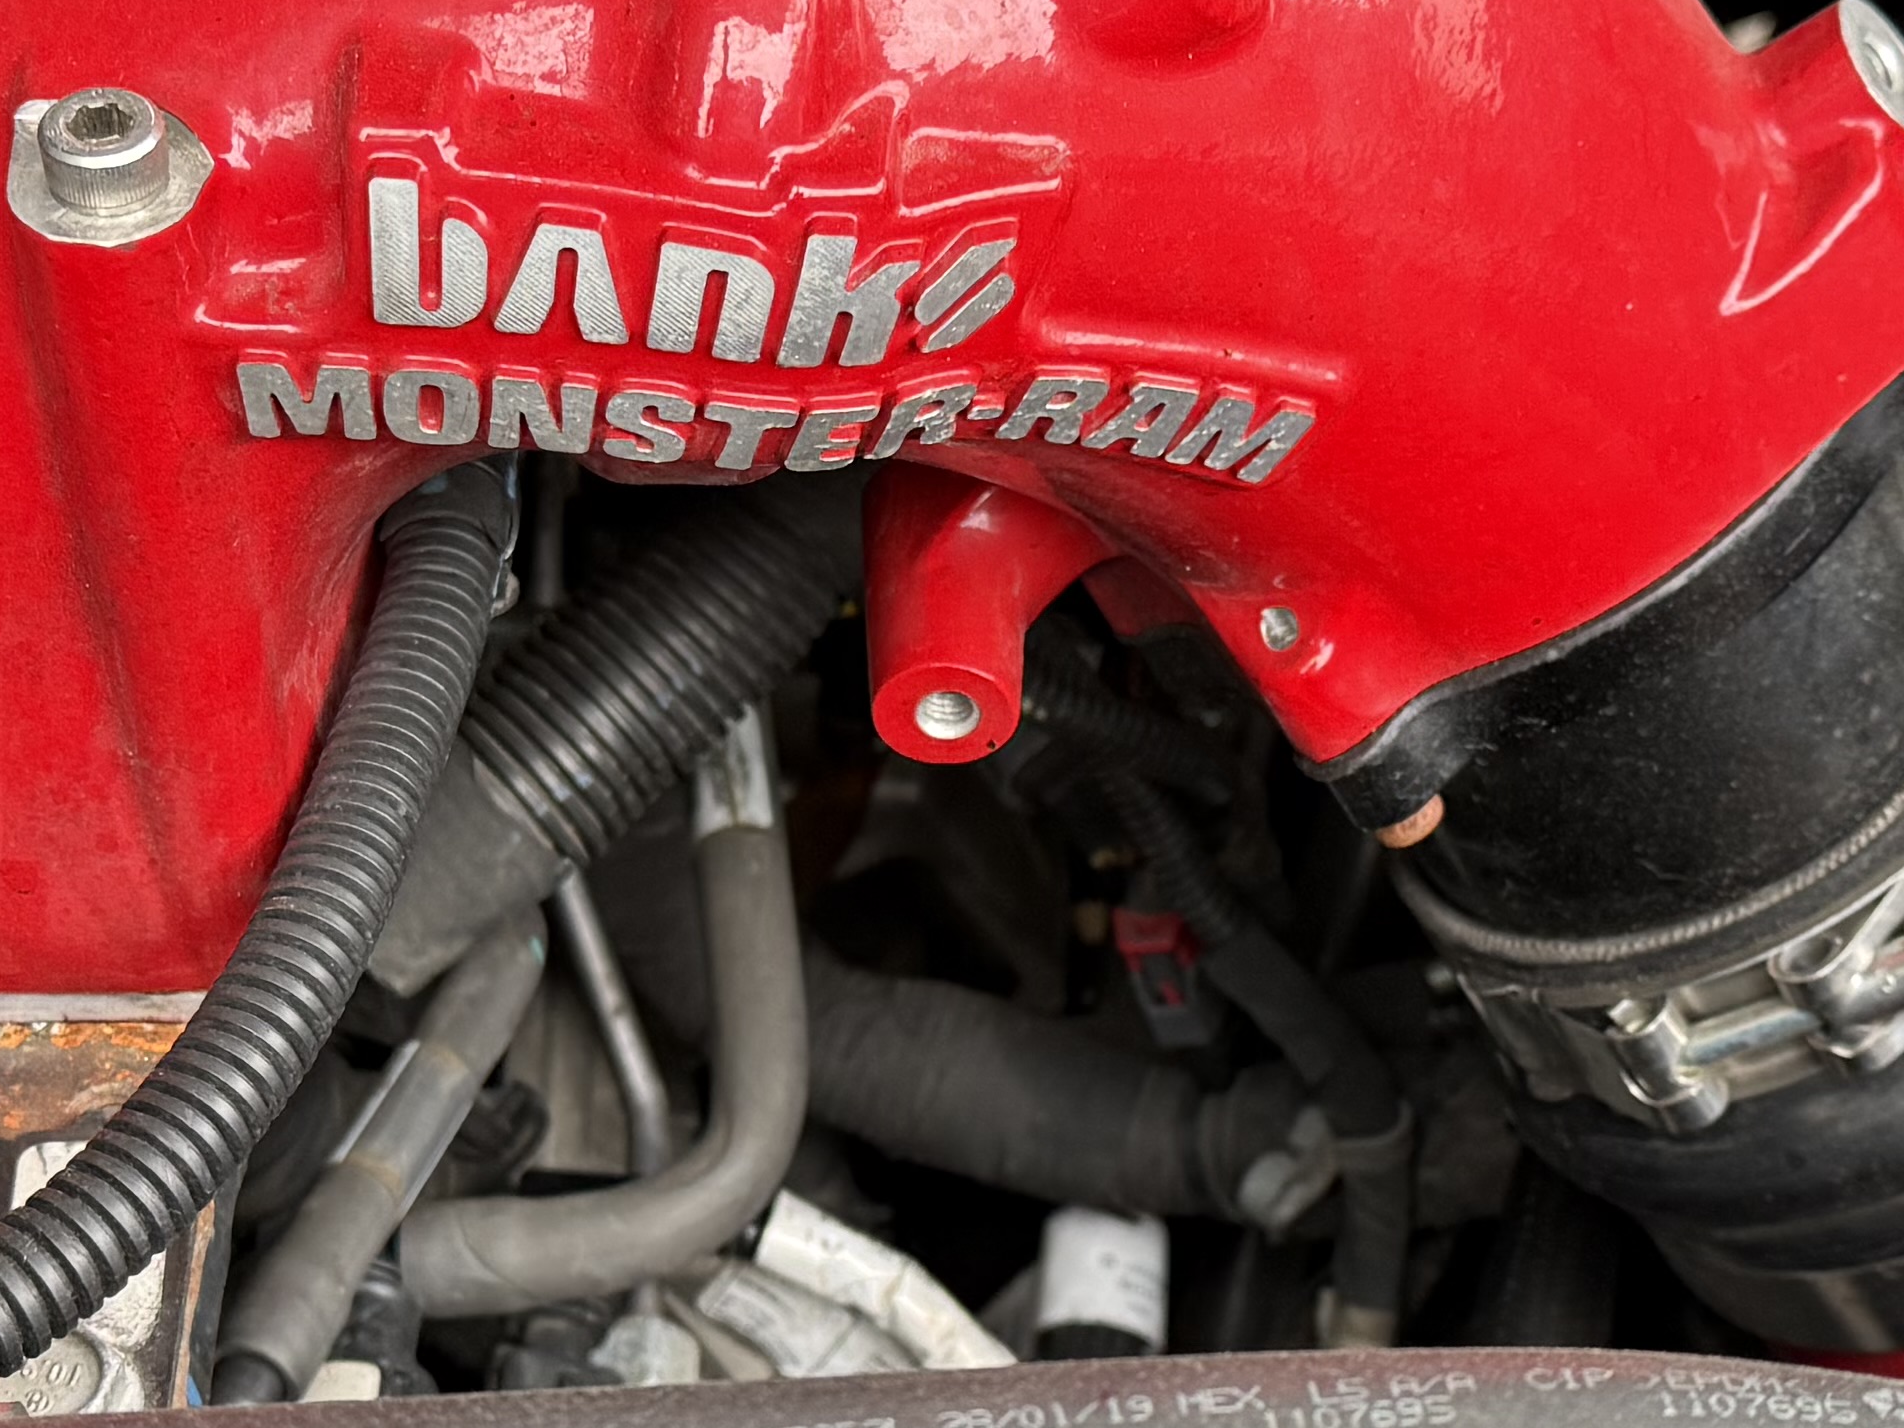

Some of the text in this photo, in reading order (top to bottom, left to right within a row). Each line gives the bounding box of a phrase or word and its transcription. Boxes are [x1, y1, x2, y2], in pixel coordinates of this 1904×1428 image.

[235, 361, 1317, 486] MONSTER-RAM
[1176, 1382, 1266, 1417] MEX
[1389, 1372, 1478, 1399] A/A
[1660, 1388, 1860, 1425] 1107695
